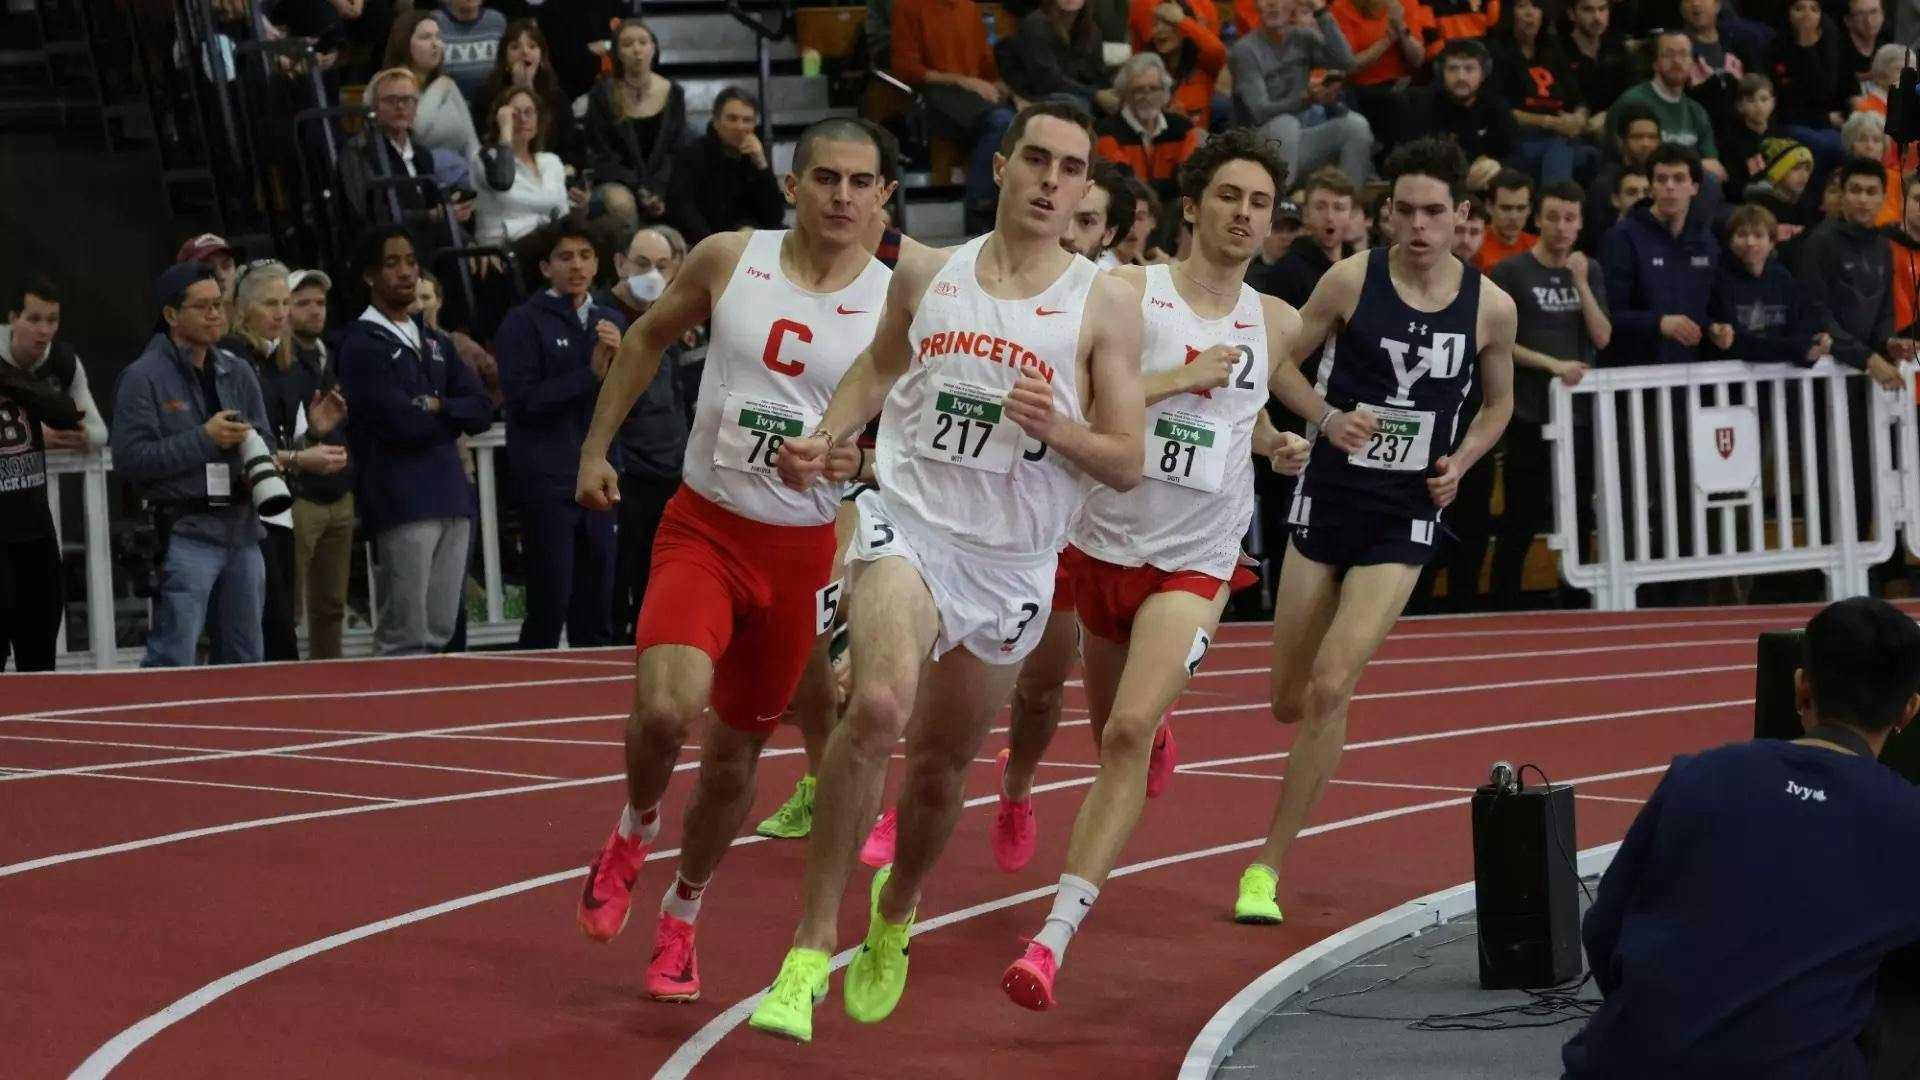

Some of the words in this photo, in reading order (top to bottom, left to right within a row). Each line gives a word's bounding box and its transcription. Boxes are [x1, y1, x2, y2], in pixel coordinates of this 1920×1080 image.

[745, 266, 763, 278] Ivy
[1151, 297, 1166, 309] Ivy
[762, 318, 814, 377] C
[918, 331, 1054, 384] PRINCETON
[1441, 336, 1456, 377] 1
[1235, 344, 1255, 390] 2
[1380, 337, 1435, 407] Y
[755, 415, 777, 430] Ivy
[951, 397, 973, 414] Ivy
[932, 413, 993, 458] 217
[1170, 425, 1191, 440] Ivy
[1381, 421, 1400, 433] Ivy
[1719, 430, 1732, 452] H
[747, 430, 784, 468] 78
[1160, 440, 1196, 478] 81
[1367, 432, 1414, 463] 237
[823, 583, 839, 630] 5
[1003, 602, 1039, 645] 3
[1785, 780, 1813, 801] Ivy
